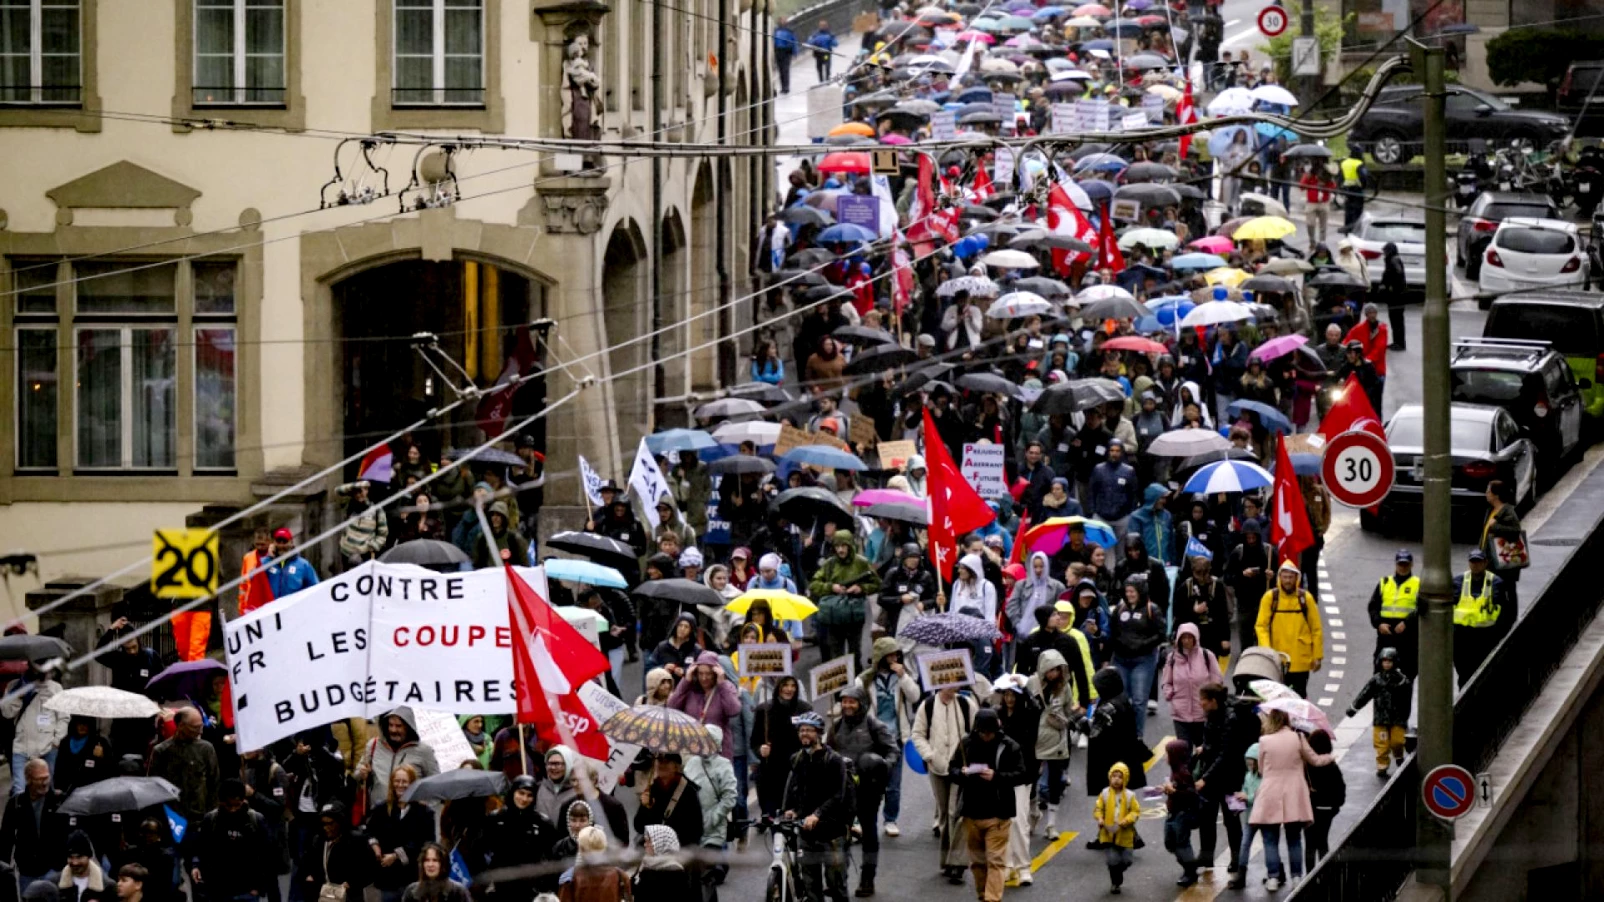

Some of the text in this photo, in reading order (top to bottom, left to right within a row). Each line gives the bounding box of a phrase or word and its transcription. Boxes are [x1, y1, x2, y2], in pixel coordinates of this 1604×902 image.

[1266, 15, 1280, 28] 30
[1344, 457, 1373, 482] 30
[156, 545, 214, 588] 20
[331, 575, 464, 602] CONTRE
[228, 612, 282, 655] UNI
[307, 628, 367, 661] LES
[232, 650, 266, 684] FR
[274, 676, 527, 724] BUDGÉTAIRES
